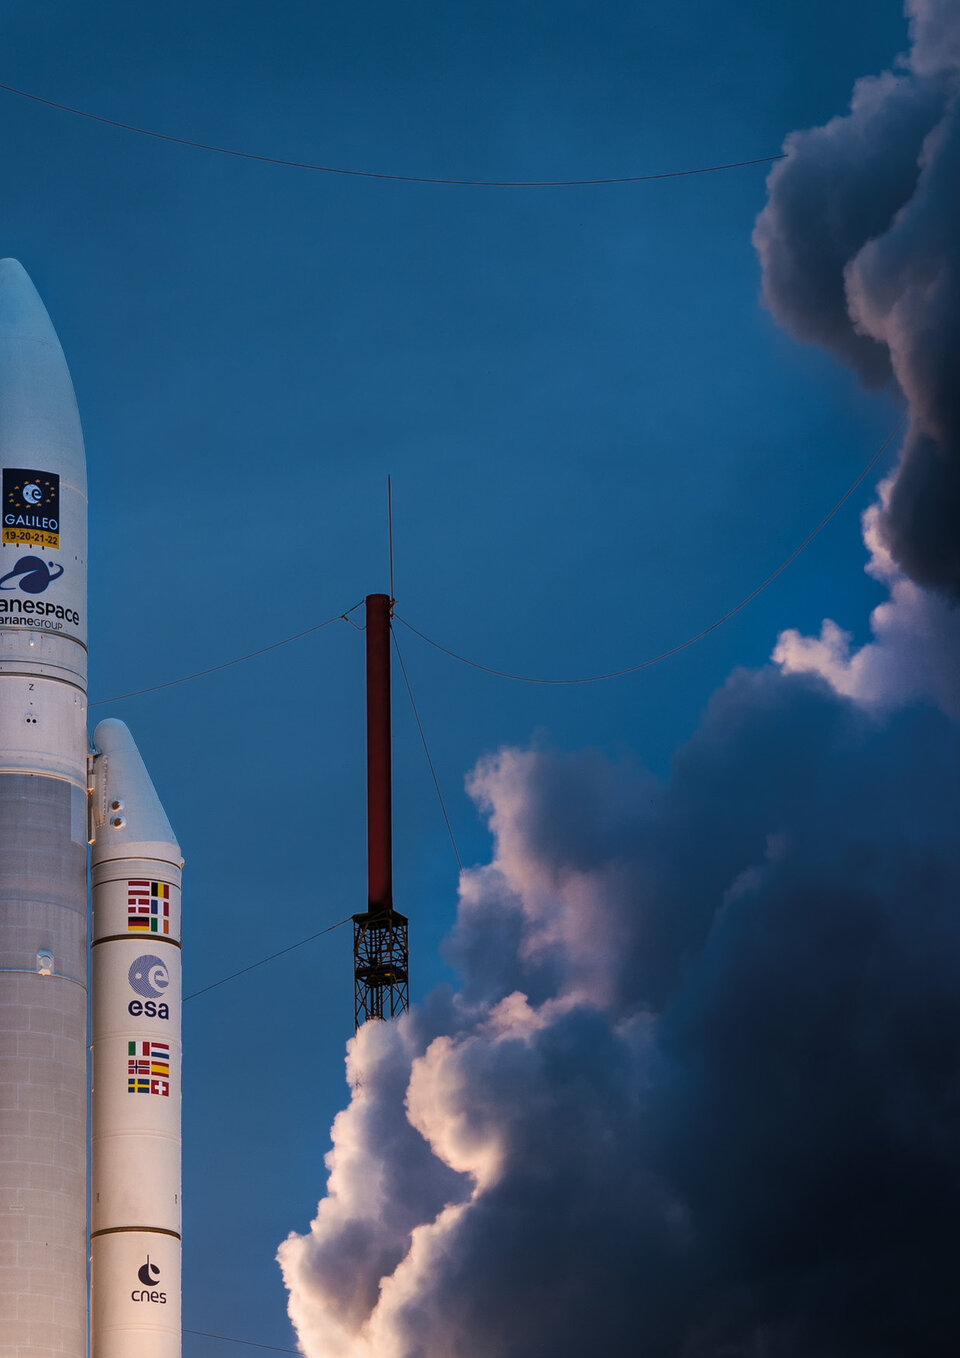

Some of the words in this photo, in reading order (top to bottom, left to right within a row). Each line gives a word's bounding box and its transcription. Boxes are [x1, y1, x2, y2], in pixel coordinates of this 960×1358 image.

[4, 513, 58, 530] GALILEO
[5, 531, 58, 545] 19-20-21-22
[128, 1000, 170, 1020] esa
[131, 1290, 167, 1304] cnes
